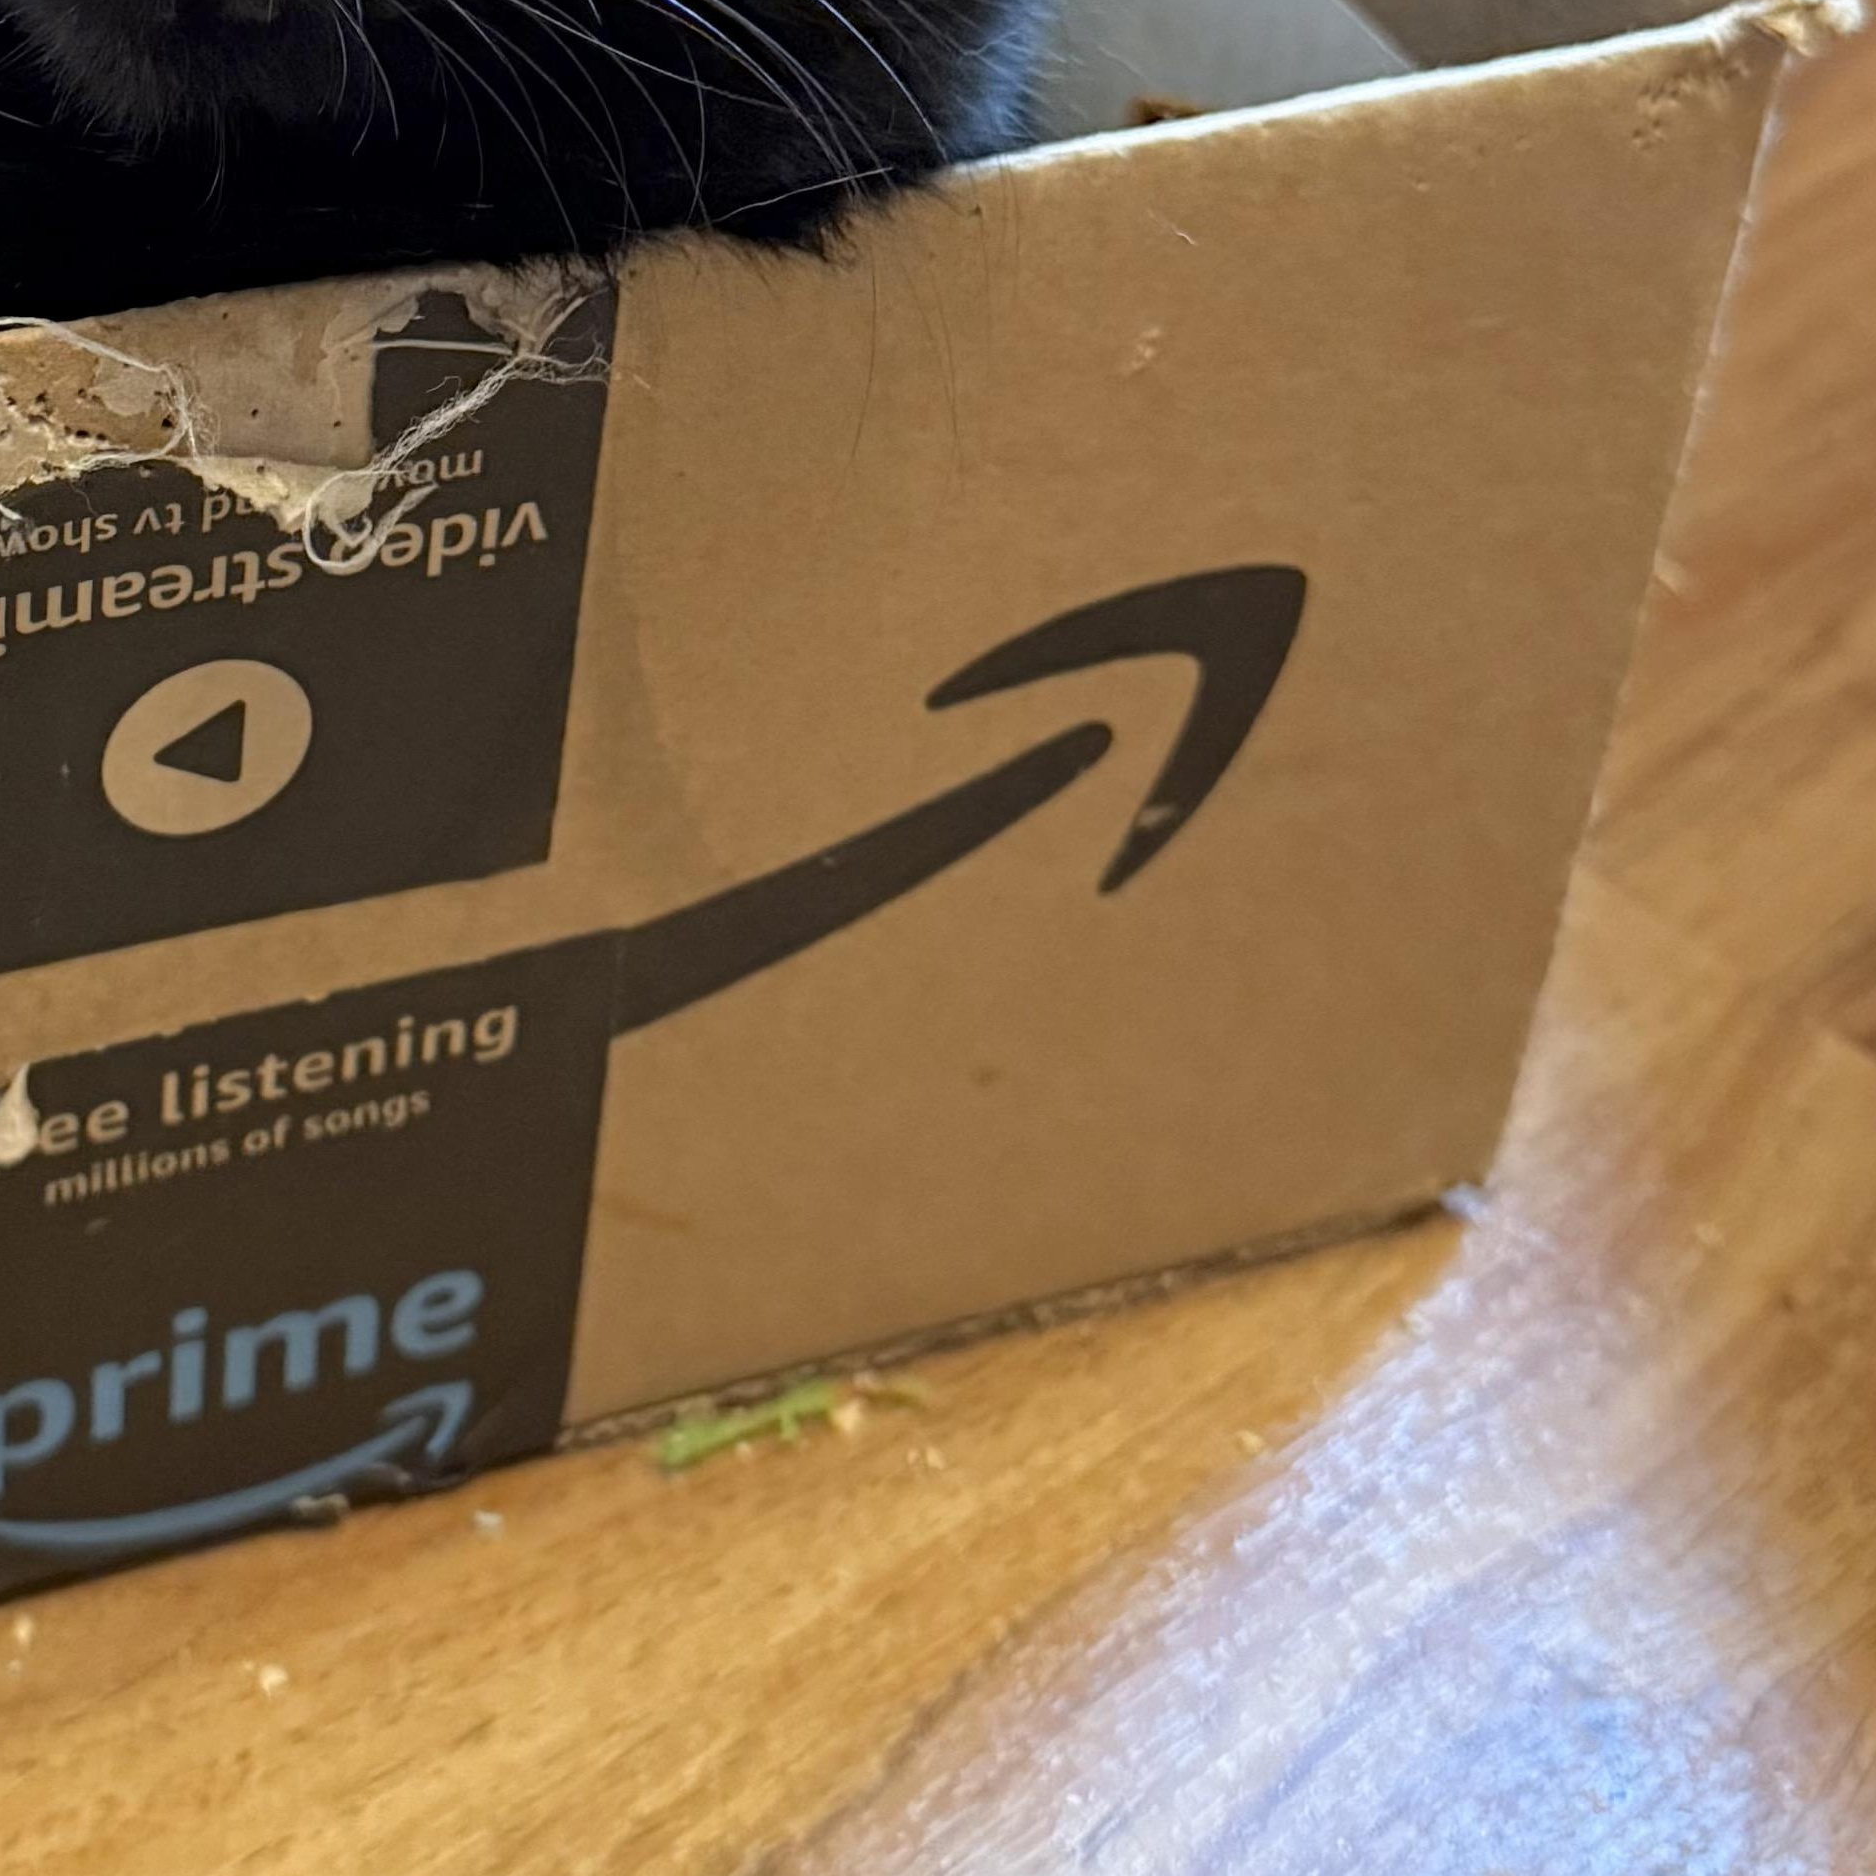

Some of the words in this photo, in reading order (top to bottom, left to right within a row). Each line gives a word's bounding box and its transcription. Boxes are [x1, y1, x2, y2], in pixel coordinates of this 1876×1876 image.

[133, 504, 185, 536] tv
[160, 1004, 519, 1127] listening
[44, 1137, 230, 1207] millions
[241, 1113, 292, 1156] of
[303, 1089, 431, 1142] songs
